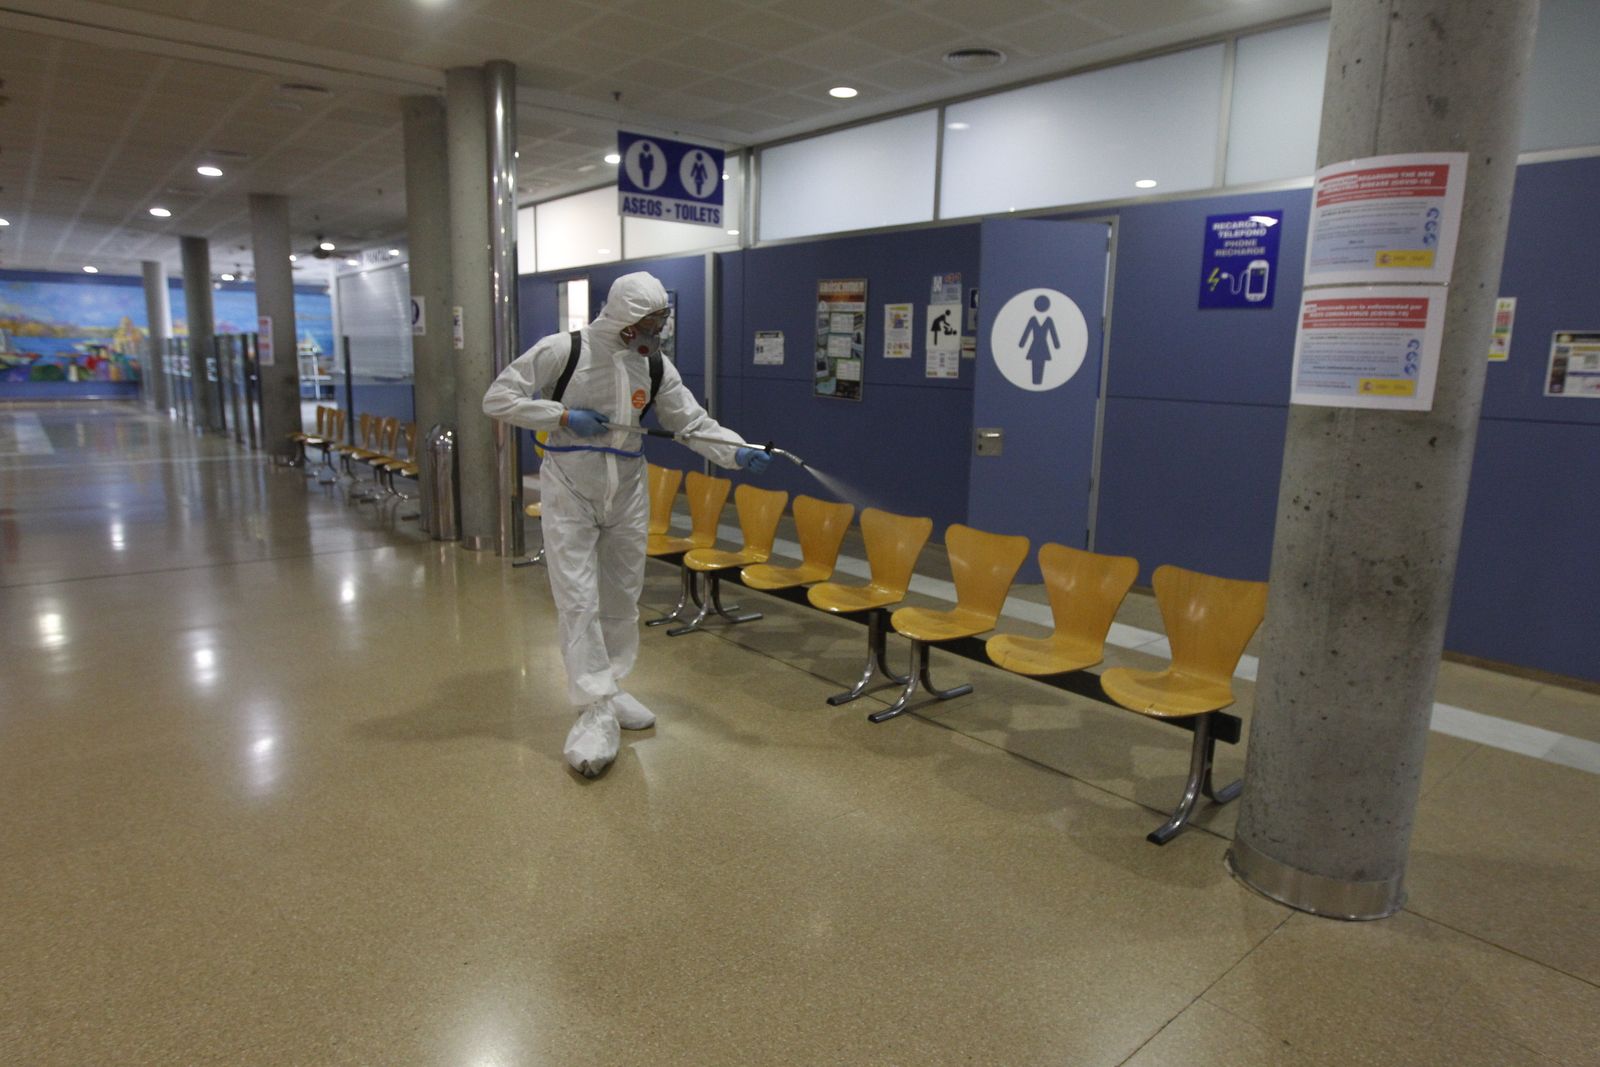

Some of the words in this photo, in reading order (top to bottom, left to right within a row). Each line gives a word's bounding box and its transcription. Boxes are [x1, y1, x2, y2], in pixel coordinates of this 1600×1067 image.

[622, 196, 662, 217] ASEOS
[674, 203, 720, 224] TOILETS
[1224, 239, 1257, 248] PHONE
[1214, 246, 1266, 257] RECHARGE
